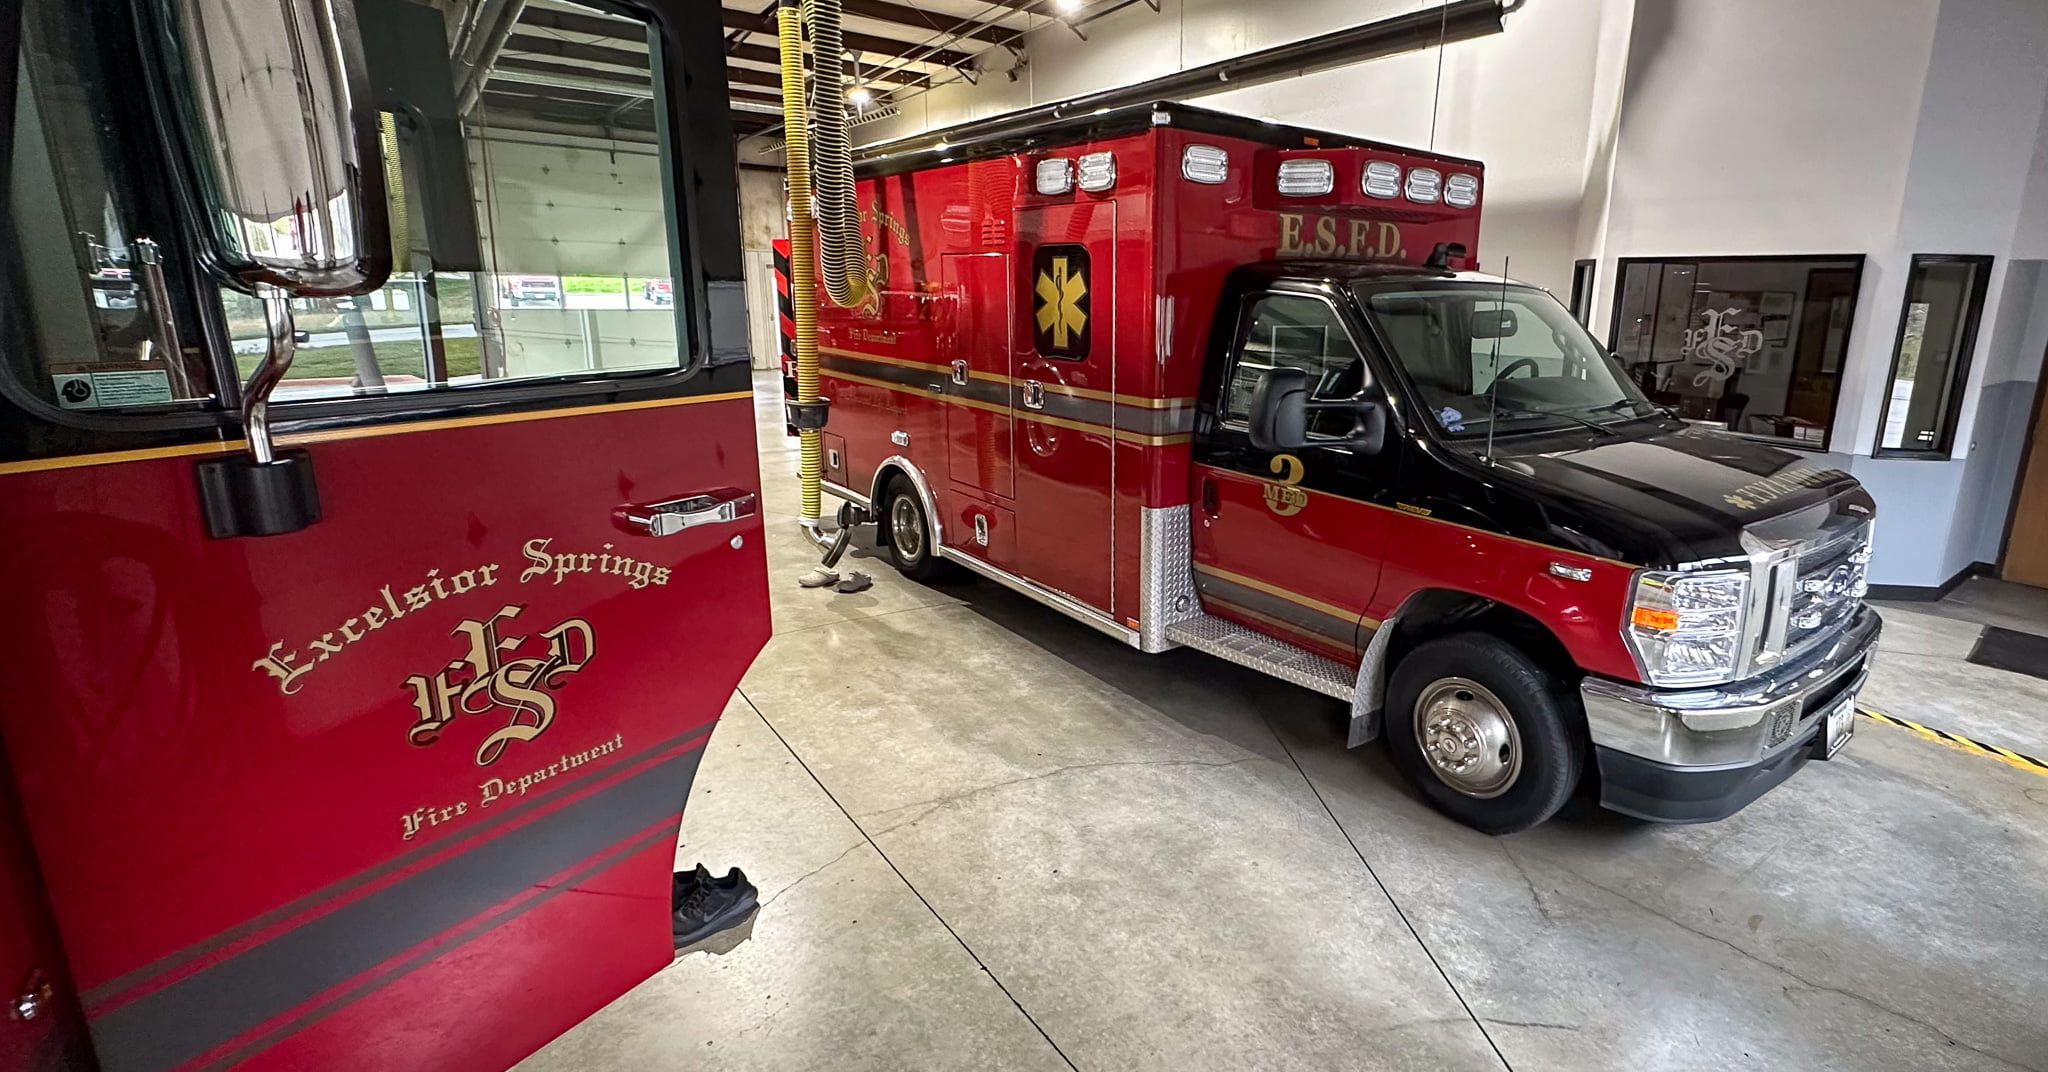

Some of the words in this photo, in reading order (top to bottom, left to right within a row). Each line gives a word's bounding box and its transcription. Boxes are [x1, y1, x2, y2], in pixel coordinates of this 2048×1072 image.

[871, 199, 911, 247] Springs
[1277, 213, 1407, 259] E.S.F.D.
[1263, 483, 1308, 508] MED
[251, 562, 499, 695] Excelsior
[519, 537, 672, 589] Springs
[402, 801, 468, 840] Fire
[479, 733, 624, 808] Department
